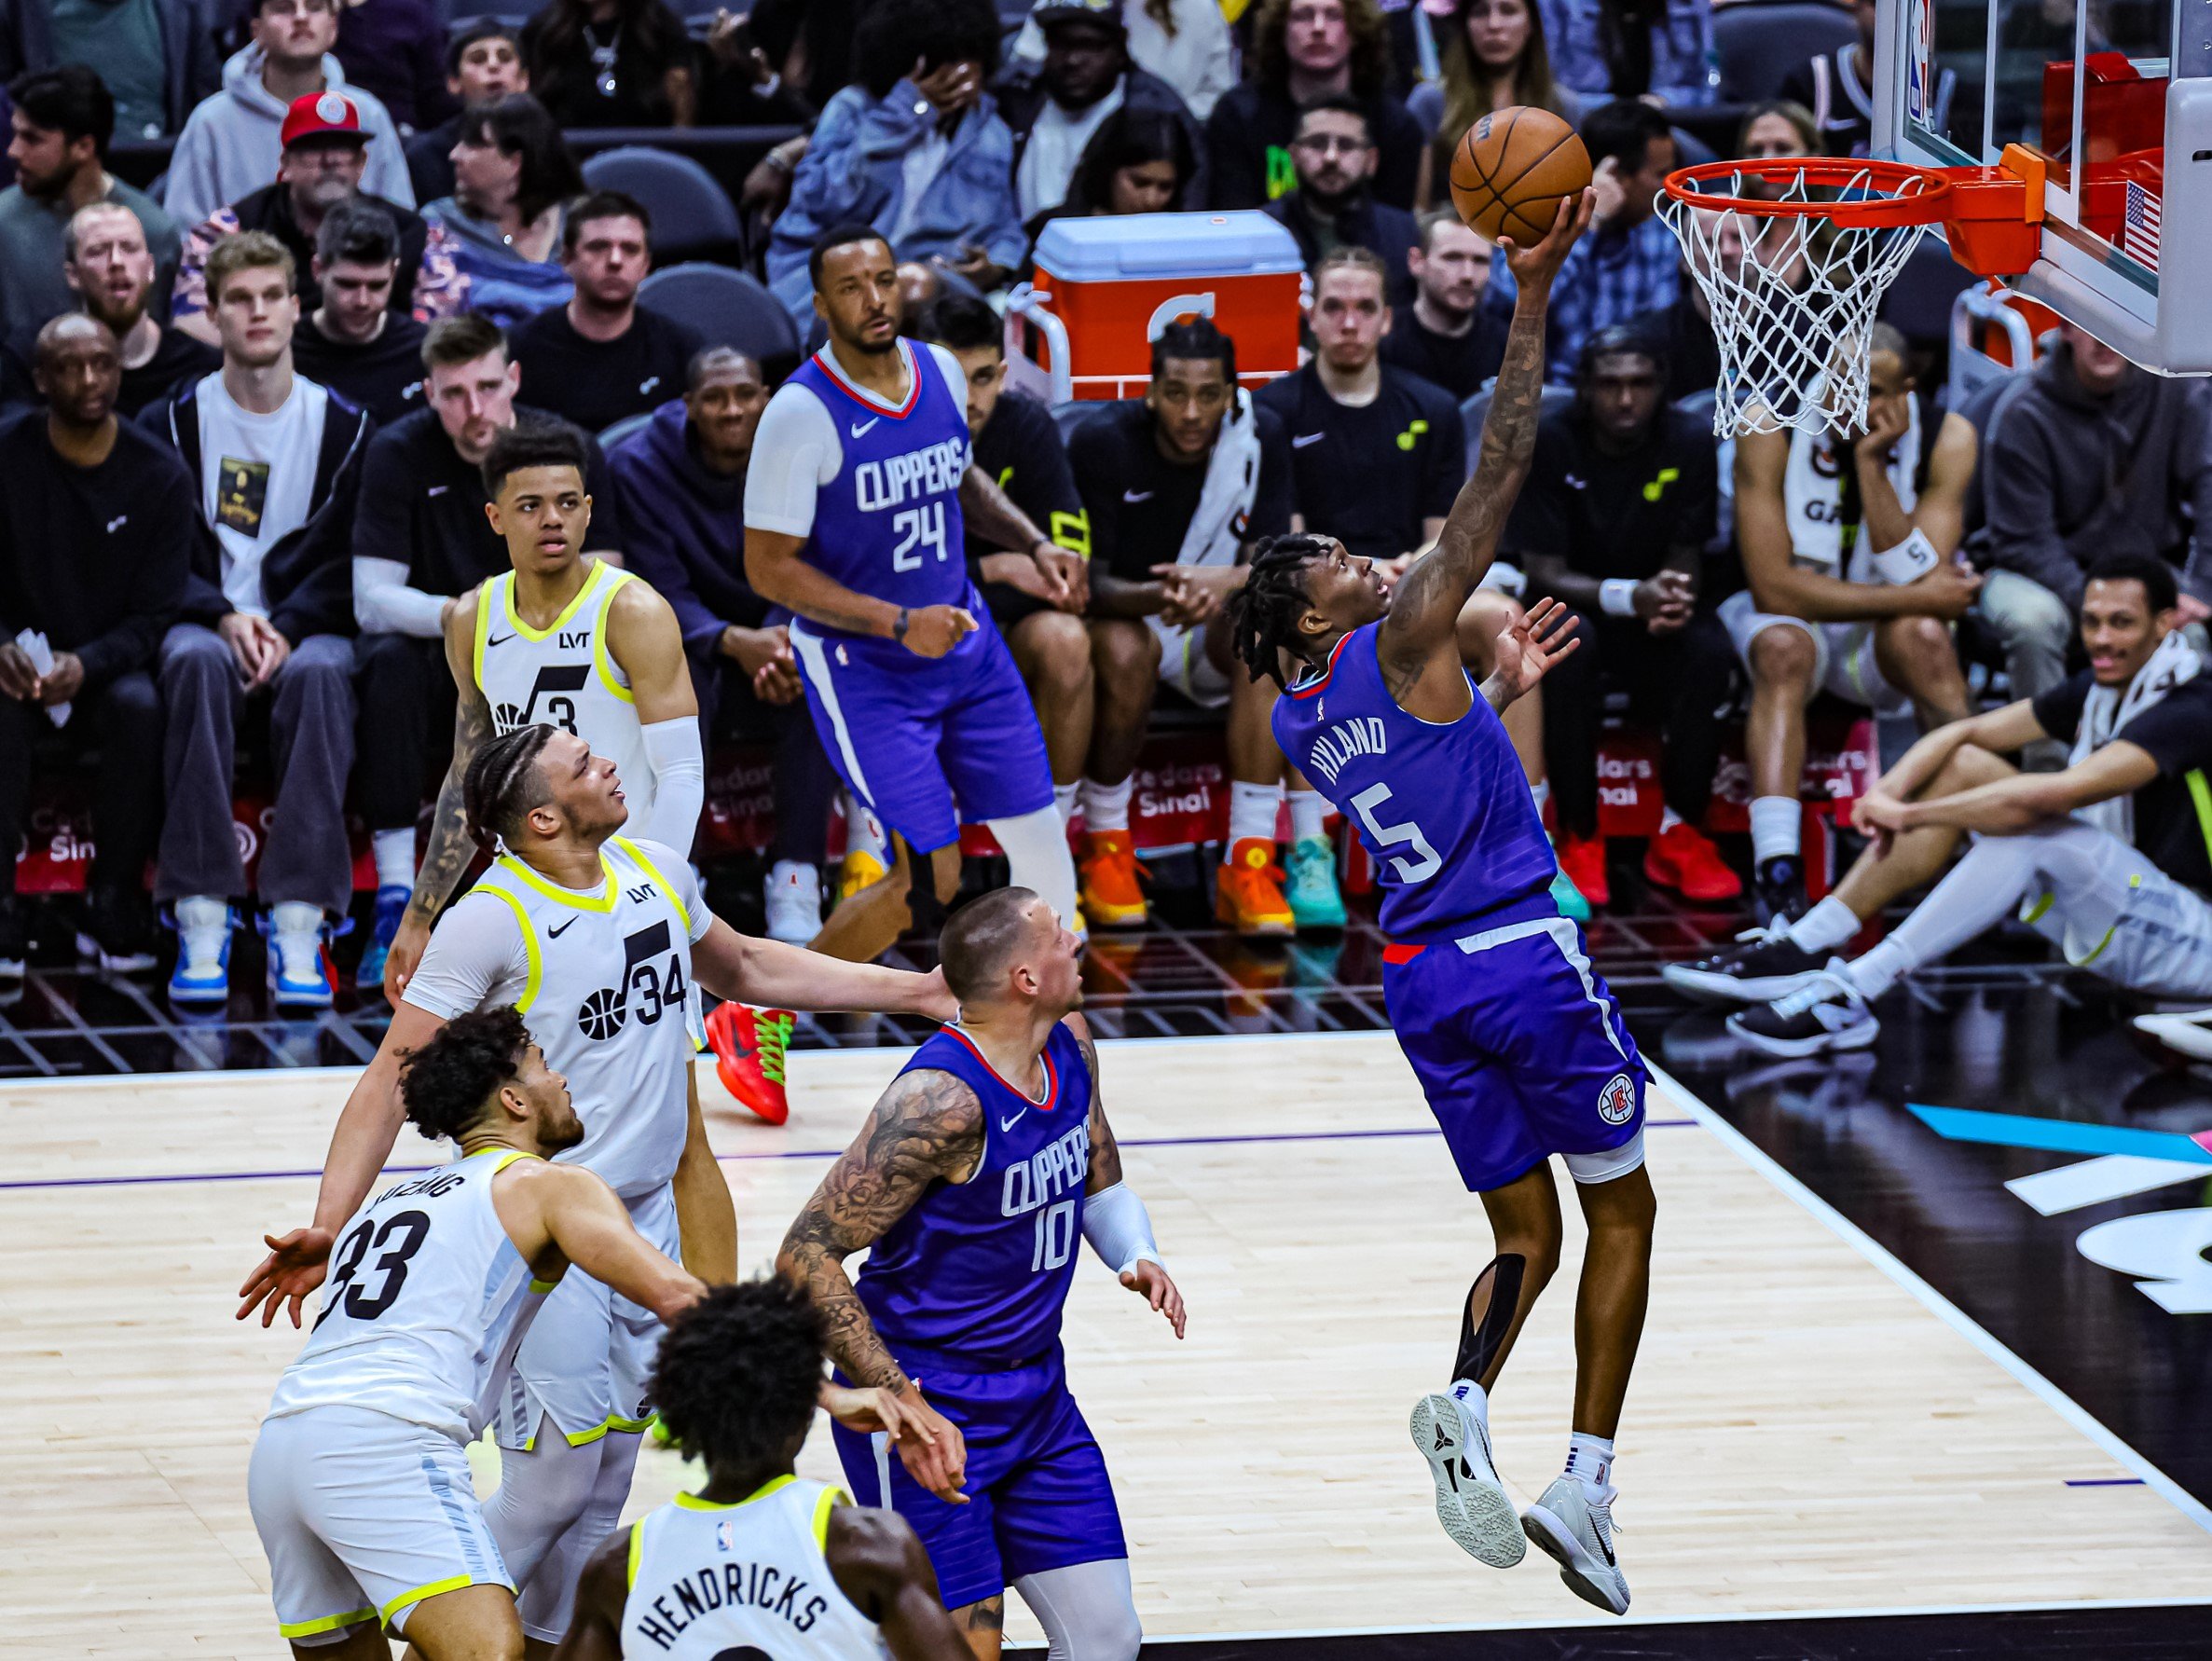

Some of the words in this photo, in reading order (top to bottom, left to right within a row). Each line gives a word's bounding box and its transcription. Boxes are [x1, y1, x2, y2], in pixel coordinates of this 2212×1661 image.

[855, 435, 963, 512] CLIPPERS
[893, 501, 947, 572] 24
[559, 631, 591, 649] LVT
[548, 696, 578, 737] 3
[1310, 717, 1387, 786] HYLAND
[1350, 781, 1442, 884] 5
[626, 883, 657, 904] LVT
[631, 953, 686, 1025] 34
[310, 1210, 431, 1333] 33
[1031, 1199, 1076, 1272] 10
[637, 1562, 828, 1651] HENDRICKS
